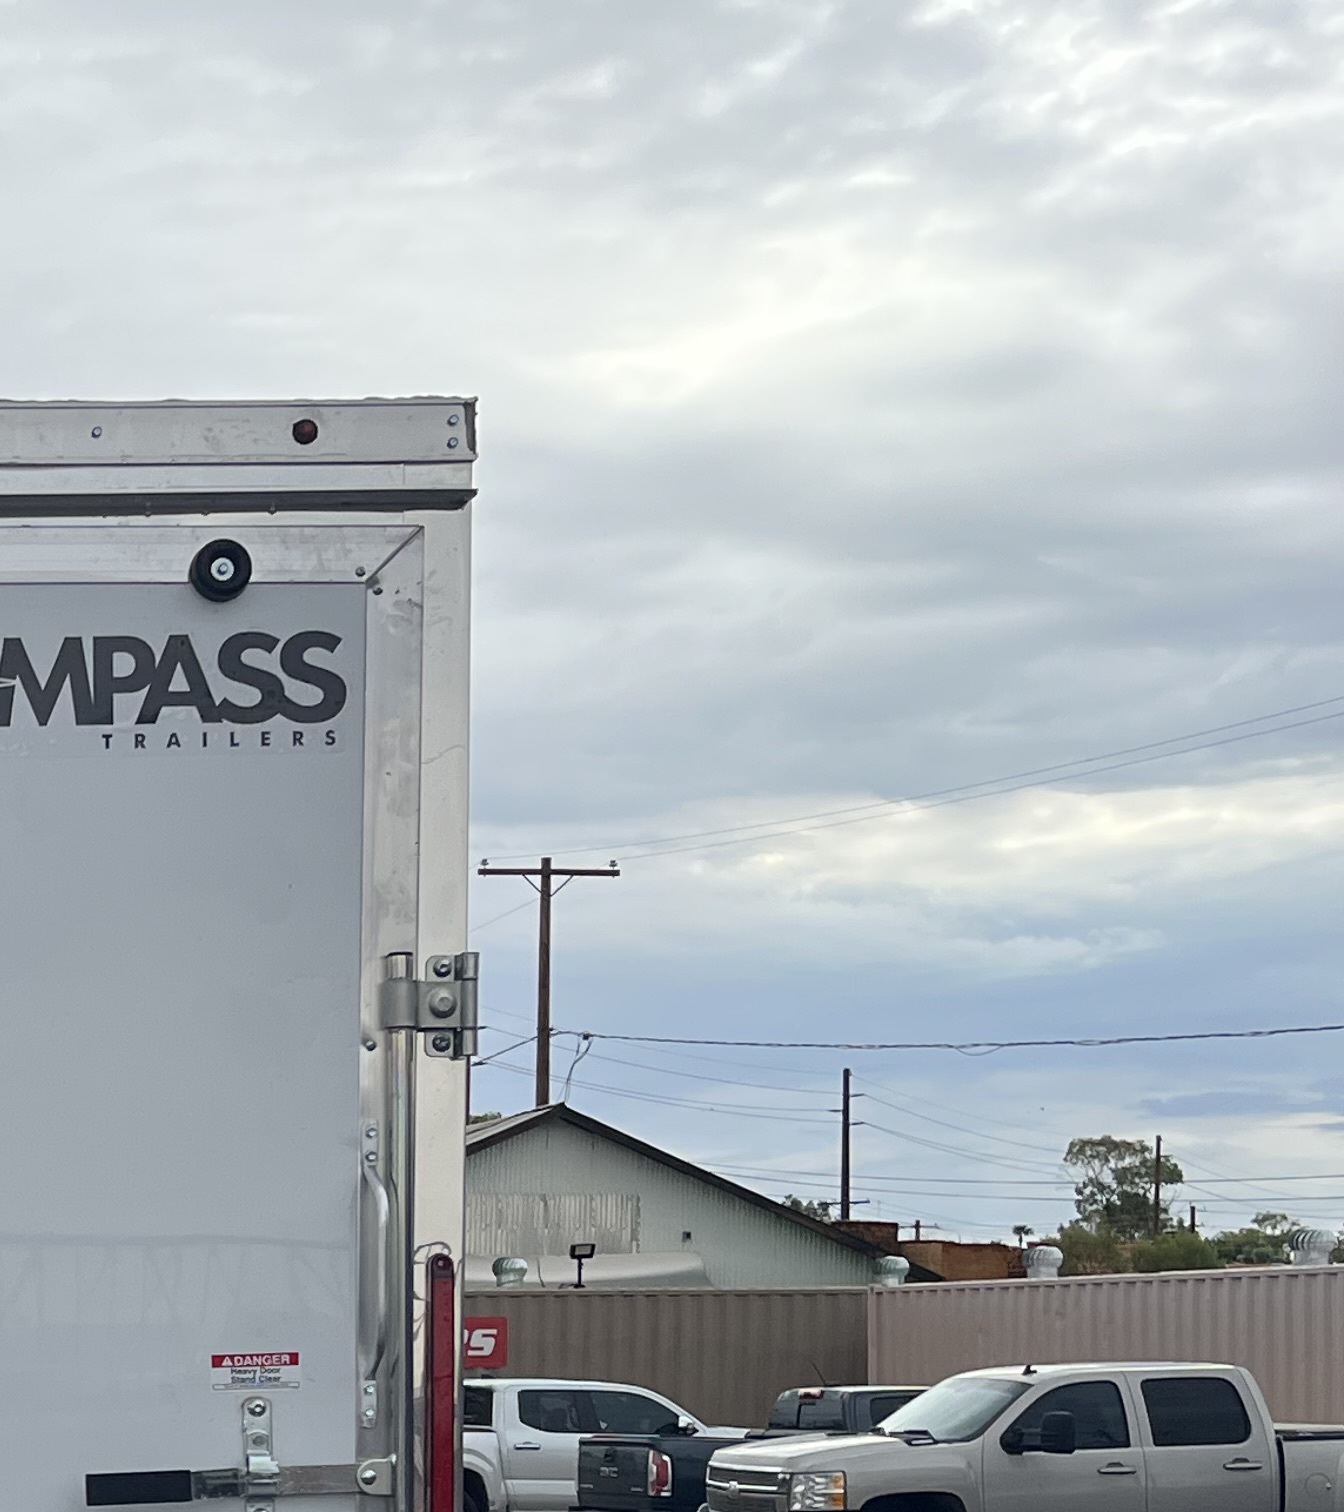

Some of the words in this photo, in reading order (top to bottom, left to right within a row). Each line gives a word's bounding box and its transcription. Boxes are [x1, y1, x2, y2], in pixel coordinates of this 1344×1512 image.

[100, 728, 339, 750] TRAILERS
[463, 1328, 498, 1357] S
[233, 1354, 291, 1366] DANGER
[259, 1366, 282, 1374] Door
[258, 1375, 282, 1383] Clear
